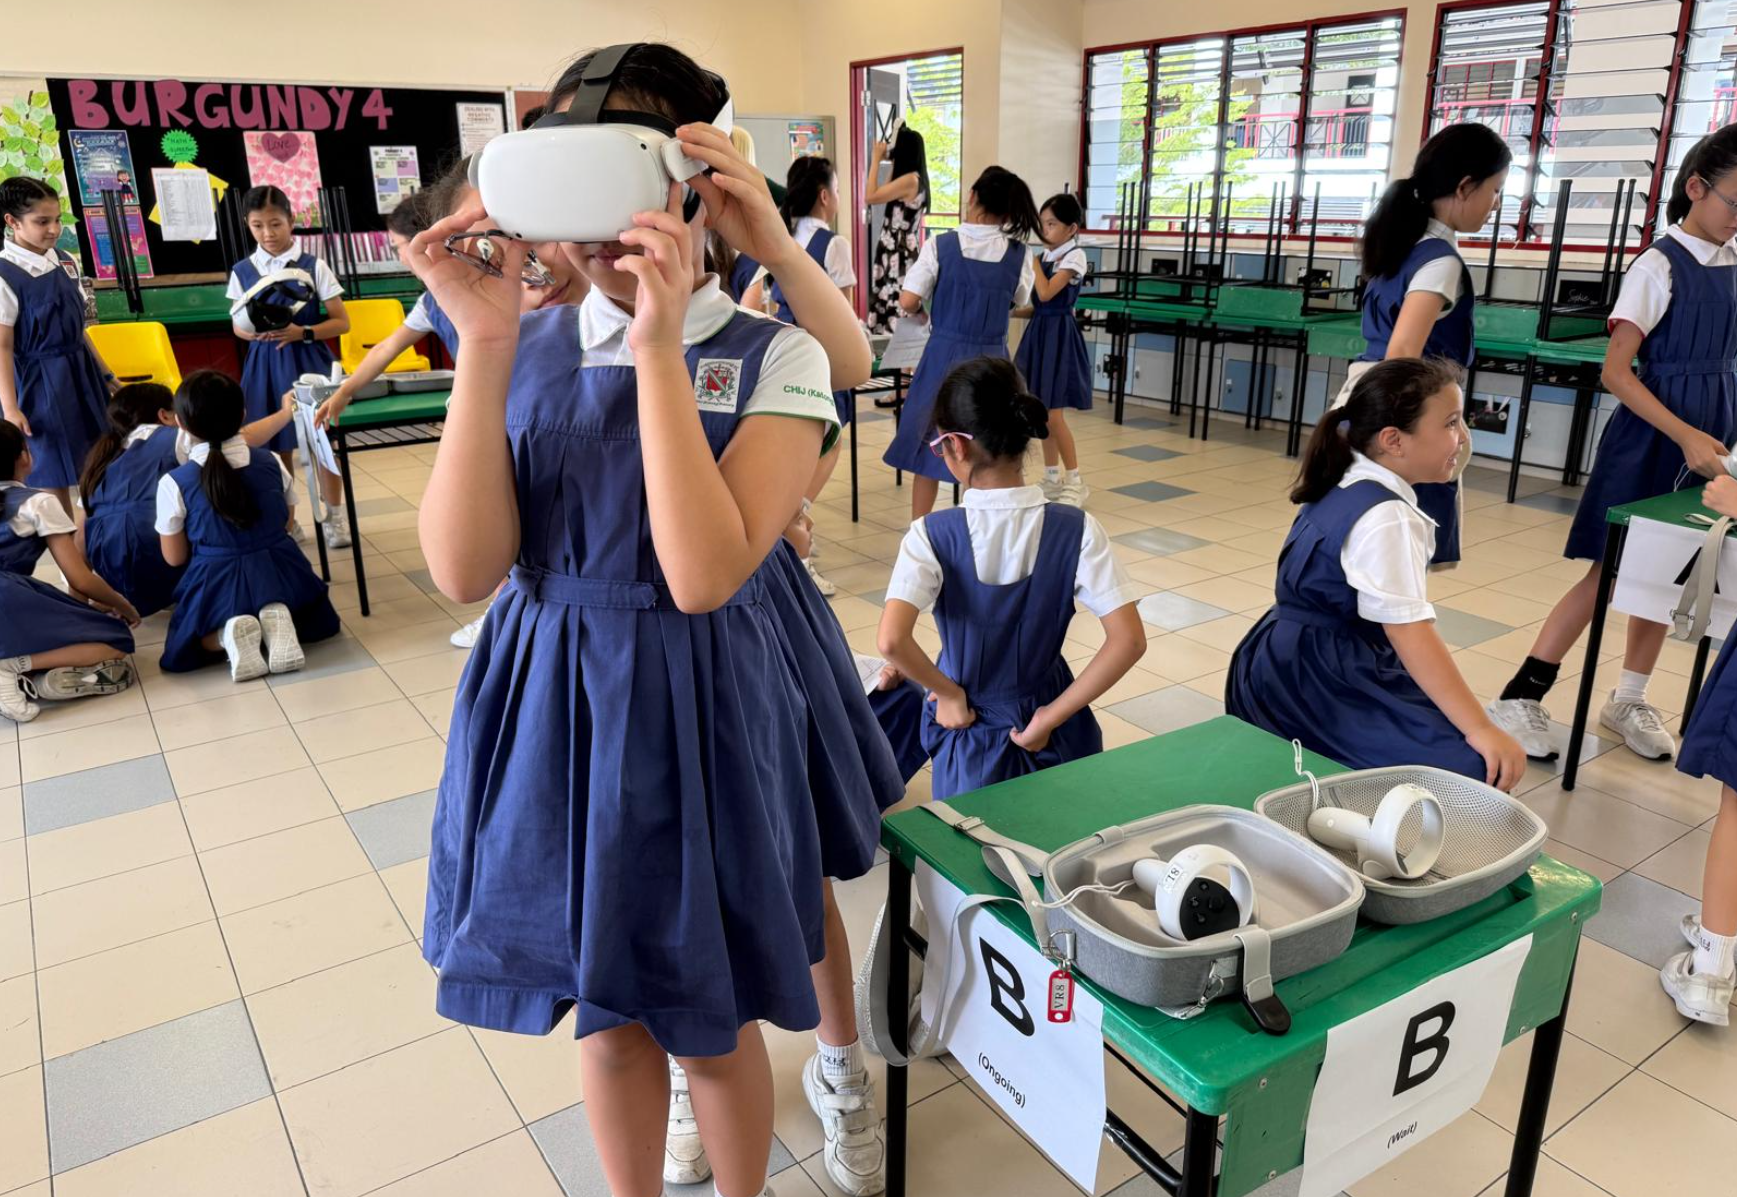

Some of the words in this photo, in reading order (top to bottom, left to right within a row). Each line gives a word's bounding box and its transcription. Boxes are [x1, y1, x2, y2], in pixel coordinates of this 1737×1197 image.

[67, 79, 354, 131] BURGUNDY
[361, 88, 393, 130] 4
[783, 384, 806, 395] CHIJ
[979, 936, 1035, 1037] B
[1053, 984, 1065, 1010] VR8
[1392, 1000, 1456, 1097] B
[978, 1052, 1026, 1109] (Ongoing)
[1387, 1121, 1418, 1149] (Wait)
